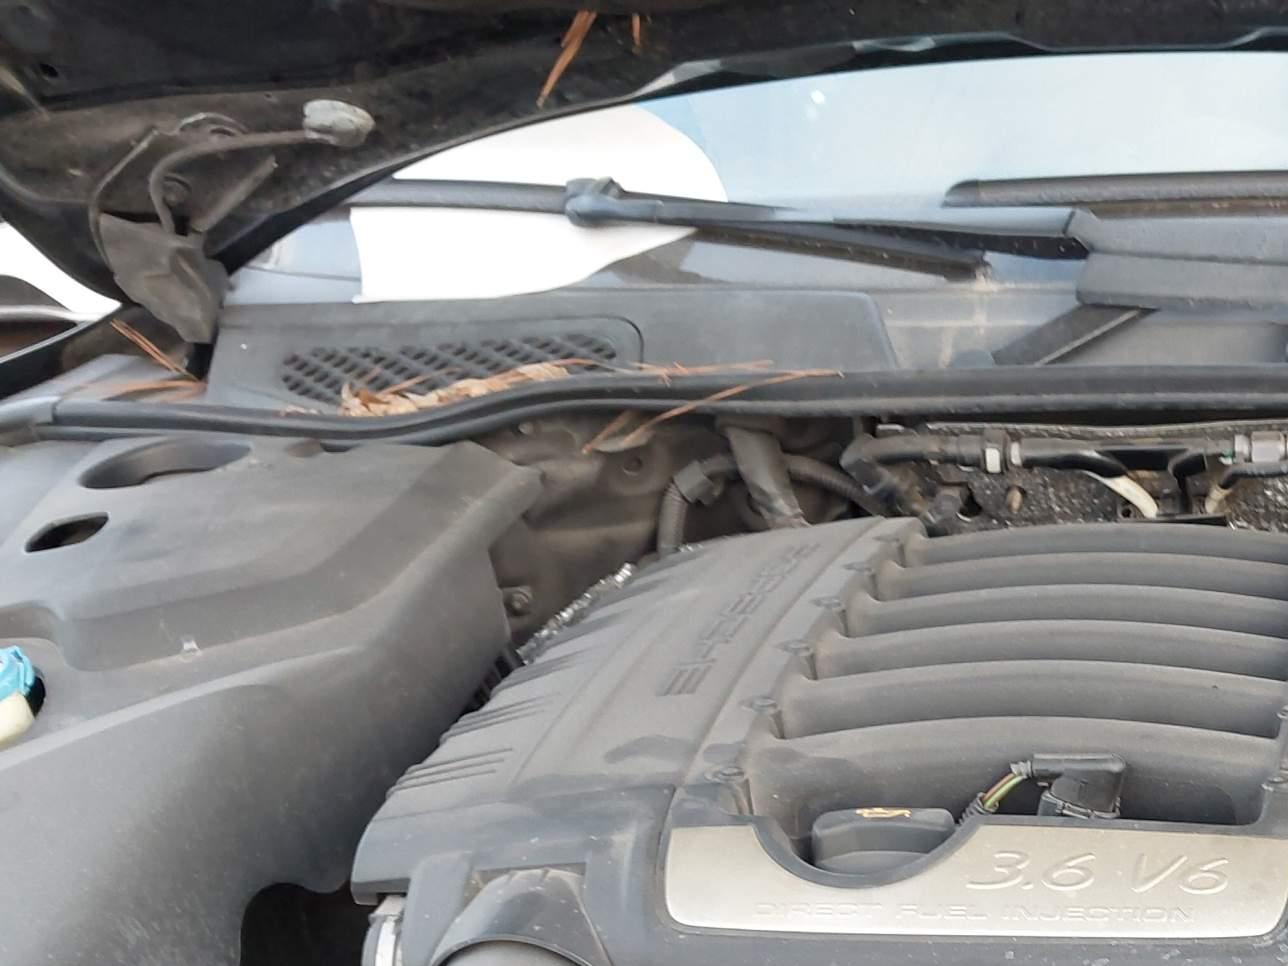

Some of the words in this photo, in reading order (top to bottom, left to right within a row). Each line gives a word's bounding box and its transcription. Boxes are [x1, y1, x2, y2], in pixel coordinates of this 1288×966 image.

[965, 850, 1096, 892] 3.6
[1130, 852, 1230, 895] V6
[752, 902, 882, 919] DIRECT
[895, 903, 989, 921] FUEL
[1001, 905, 1196, 923] INJECTION
